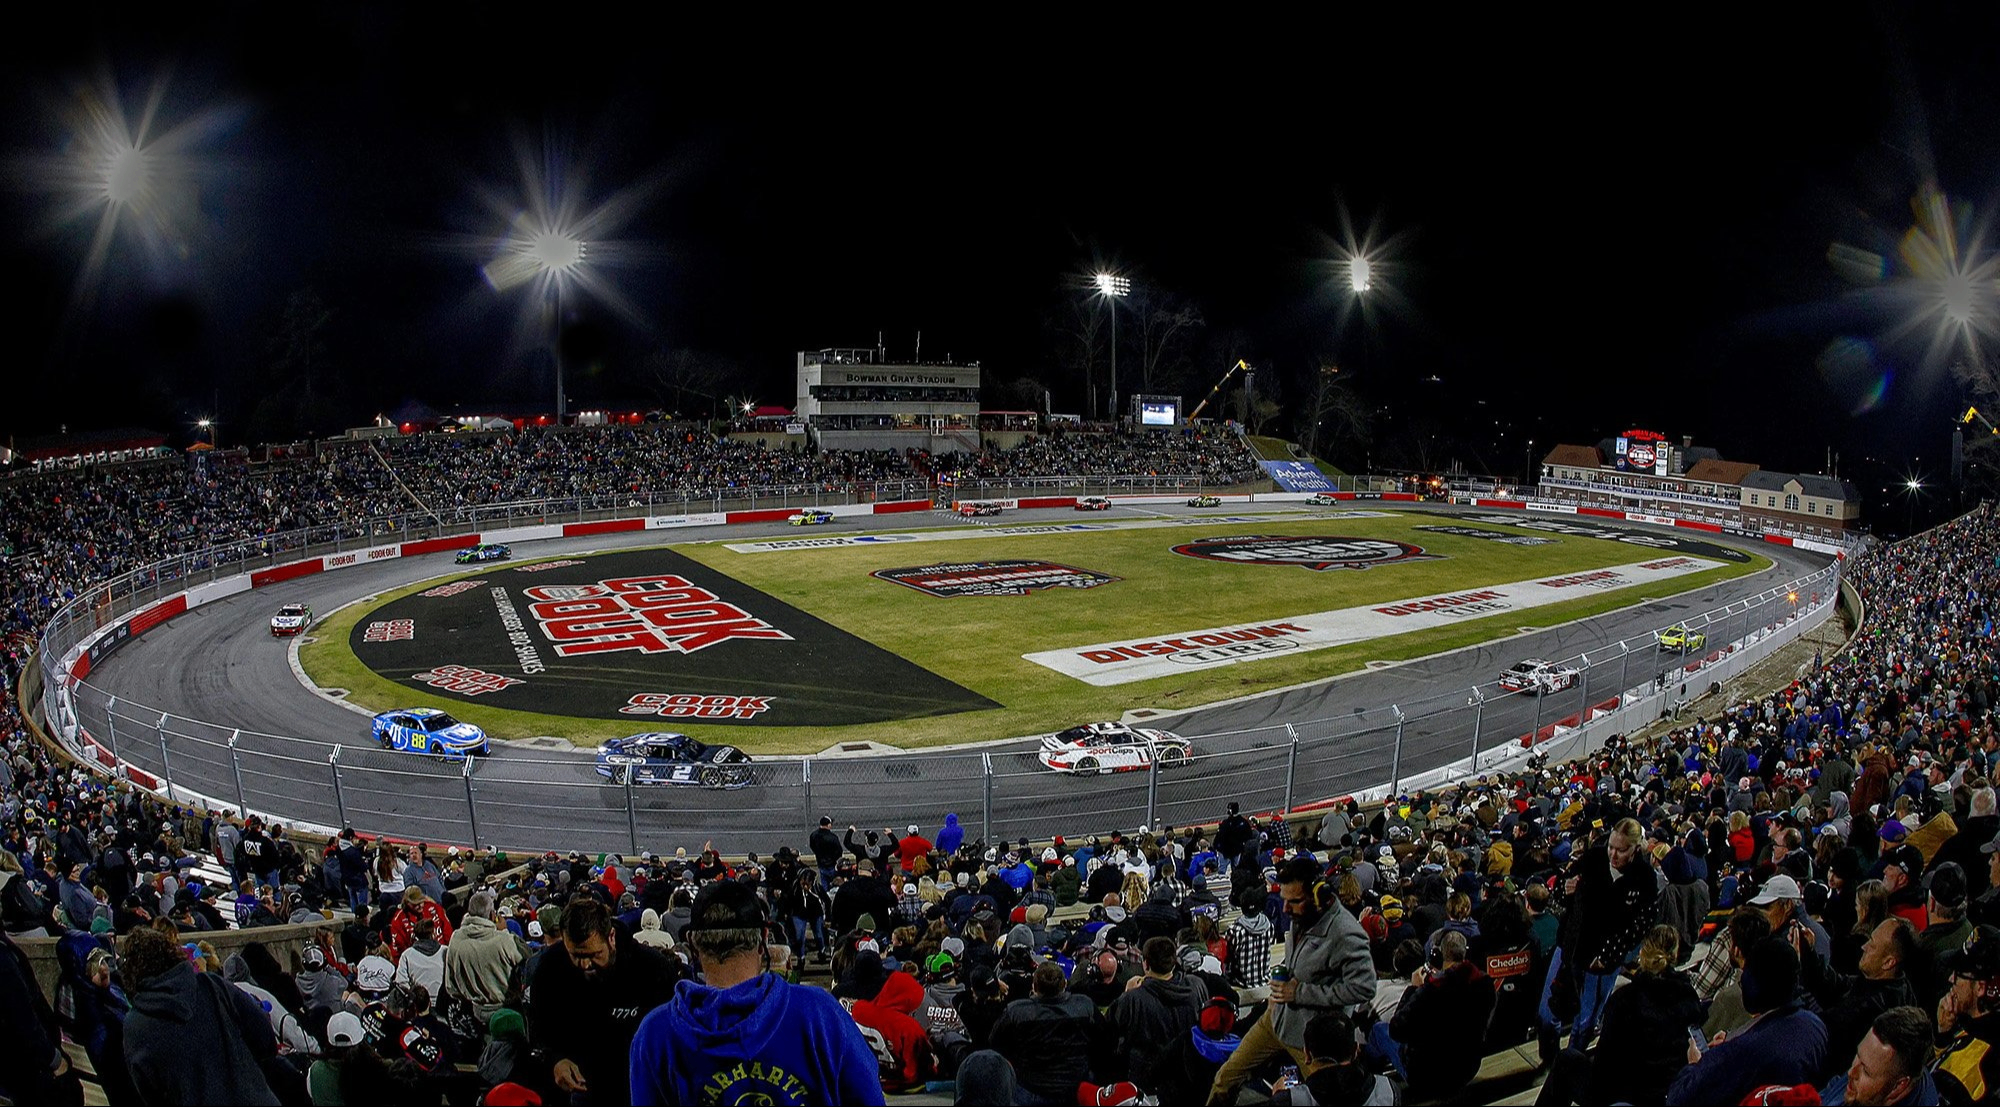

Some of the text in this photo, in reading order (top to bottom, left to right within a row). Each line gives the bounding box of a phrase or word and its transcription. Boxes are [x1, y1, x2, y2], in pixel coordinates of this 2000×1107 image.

[846, 373, 956, 384] BOWMAN GRAY STADIUM
[1275, 468, 1320, 480] Advent
[1287, 478, 1330, 489] Health
[332, 554, 356, 567] COOK OUT
[371, 547, 396, 559] COOK OUT
[1372, 590, 1510, 617] DISCOUNT
[599, 574, 796, 656] COOK
[527, 596, 680, 658] OUT
[1077, 622, 1312, 664] DISCOUNT
[1176, 638, 1282, 662] TIRE
[426, 675, 499, 697] OUT
[431, 665, 527, 691] COOK
[631, 693, 778, 710] COOK
[657, 704, 768, 720] OUT
[411, 732, 427, 750] 88
[672, 765, 693, 780] 2
[611, 1006, 640, 1019] 1776
[703, 1061, 809, 1107] ARHARTT
